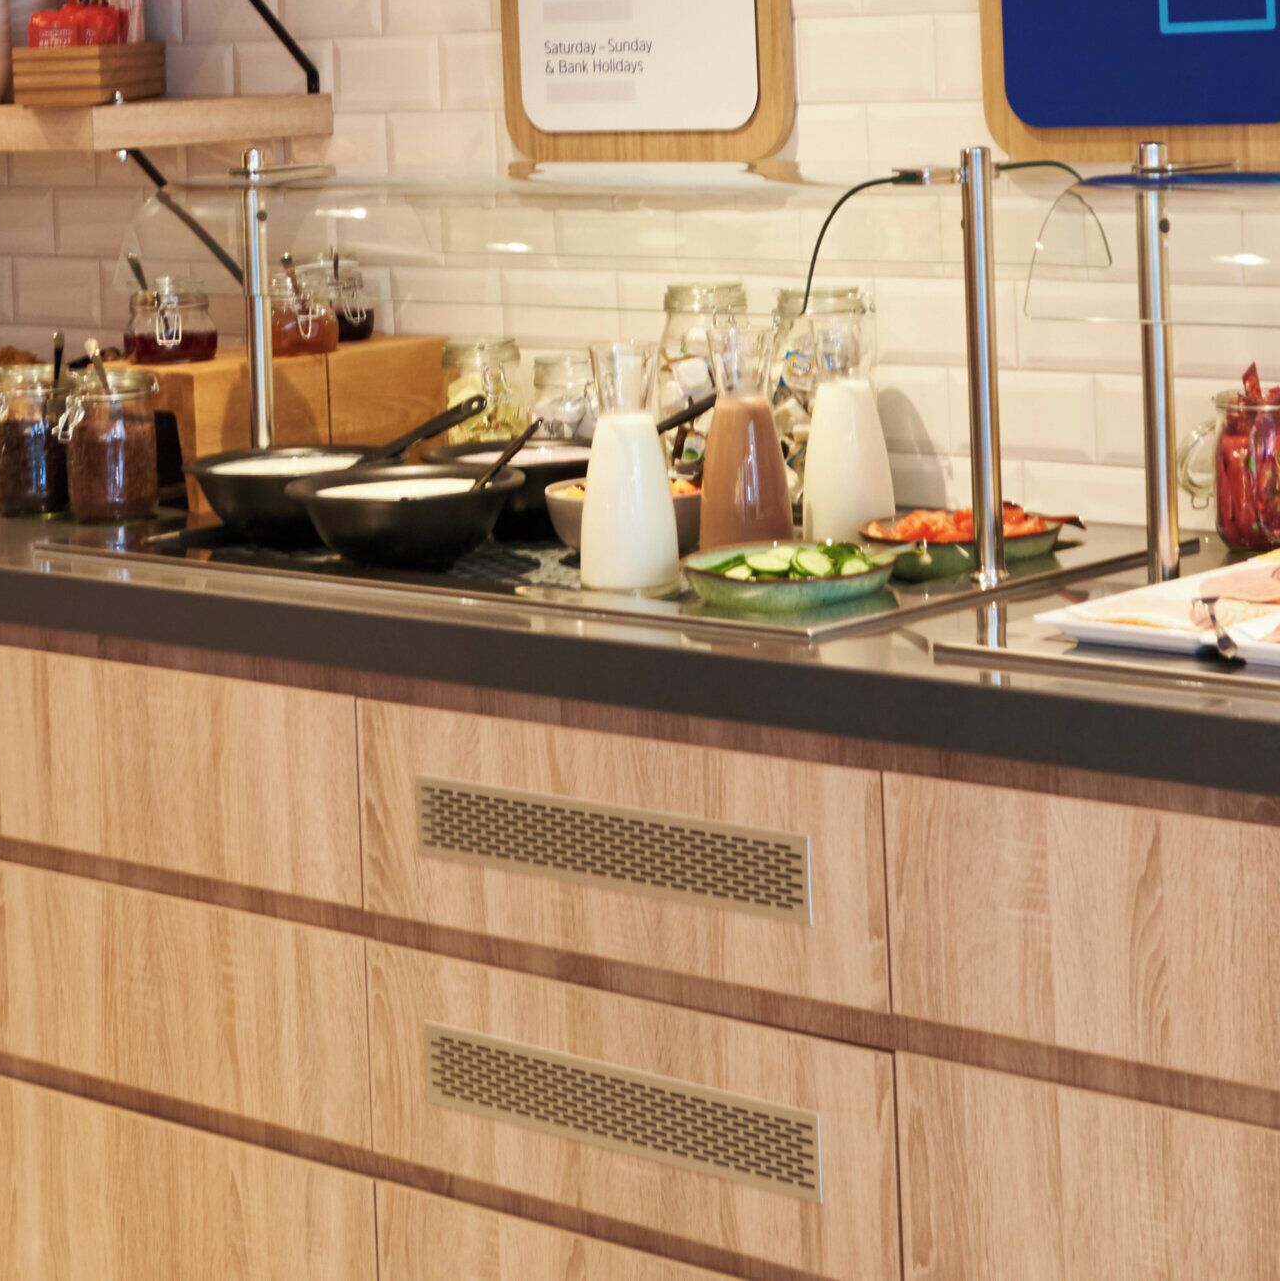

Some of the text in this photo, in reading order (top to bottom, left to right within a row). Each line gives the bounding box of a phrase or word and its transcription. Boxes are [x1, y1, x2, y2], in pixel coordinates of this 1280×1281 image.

[544, 40, 597, 55] Saturday
[607, 38, 653, 54] Sunday
[545, 58, 644, 74] & Bank Holidays
